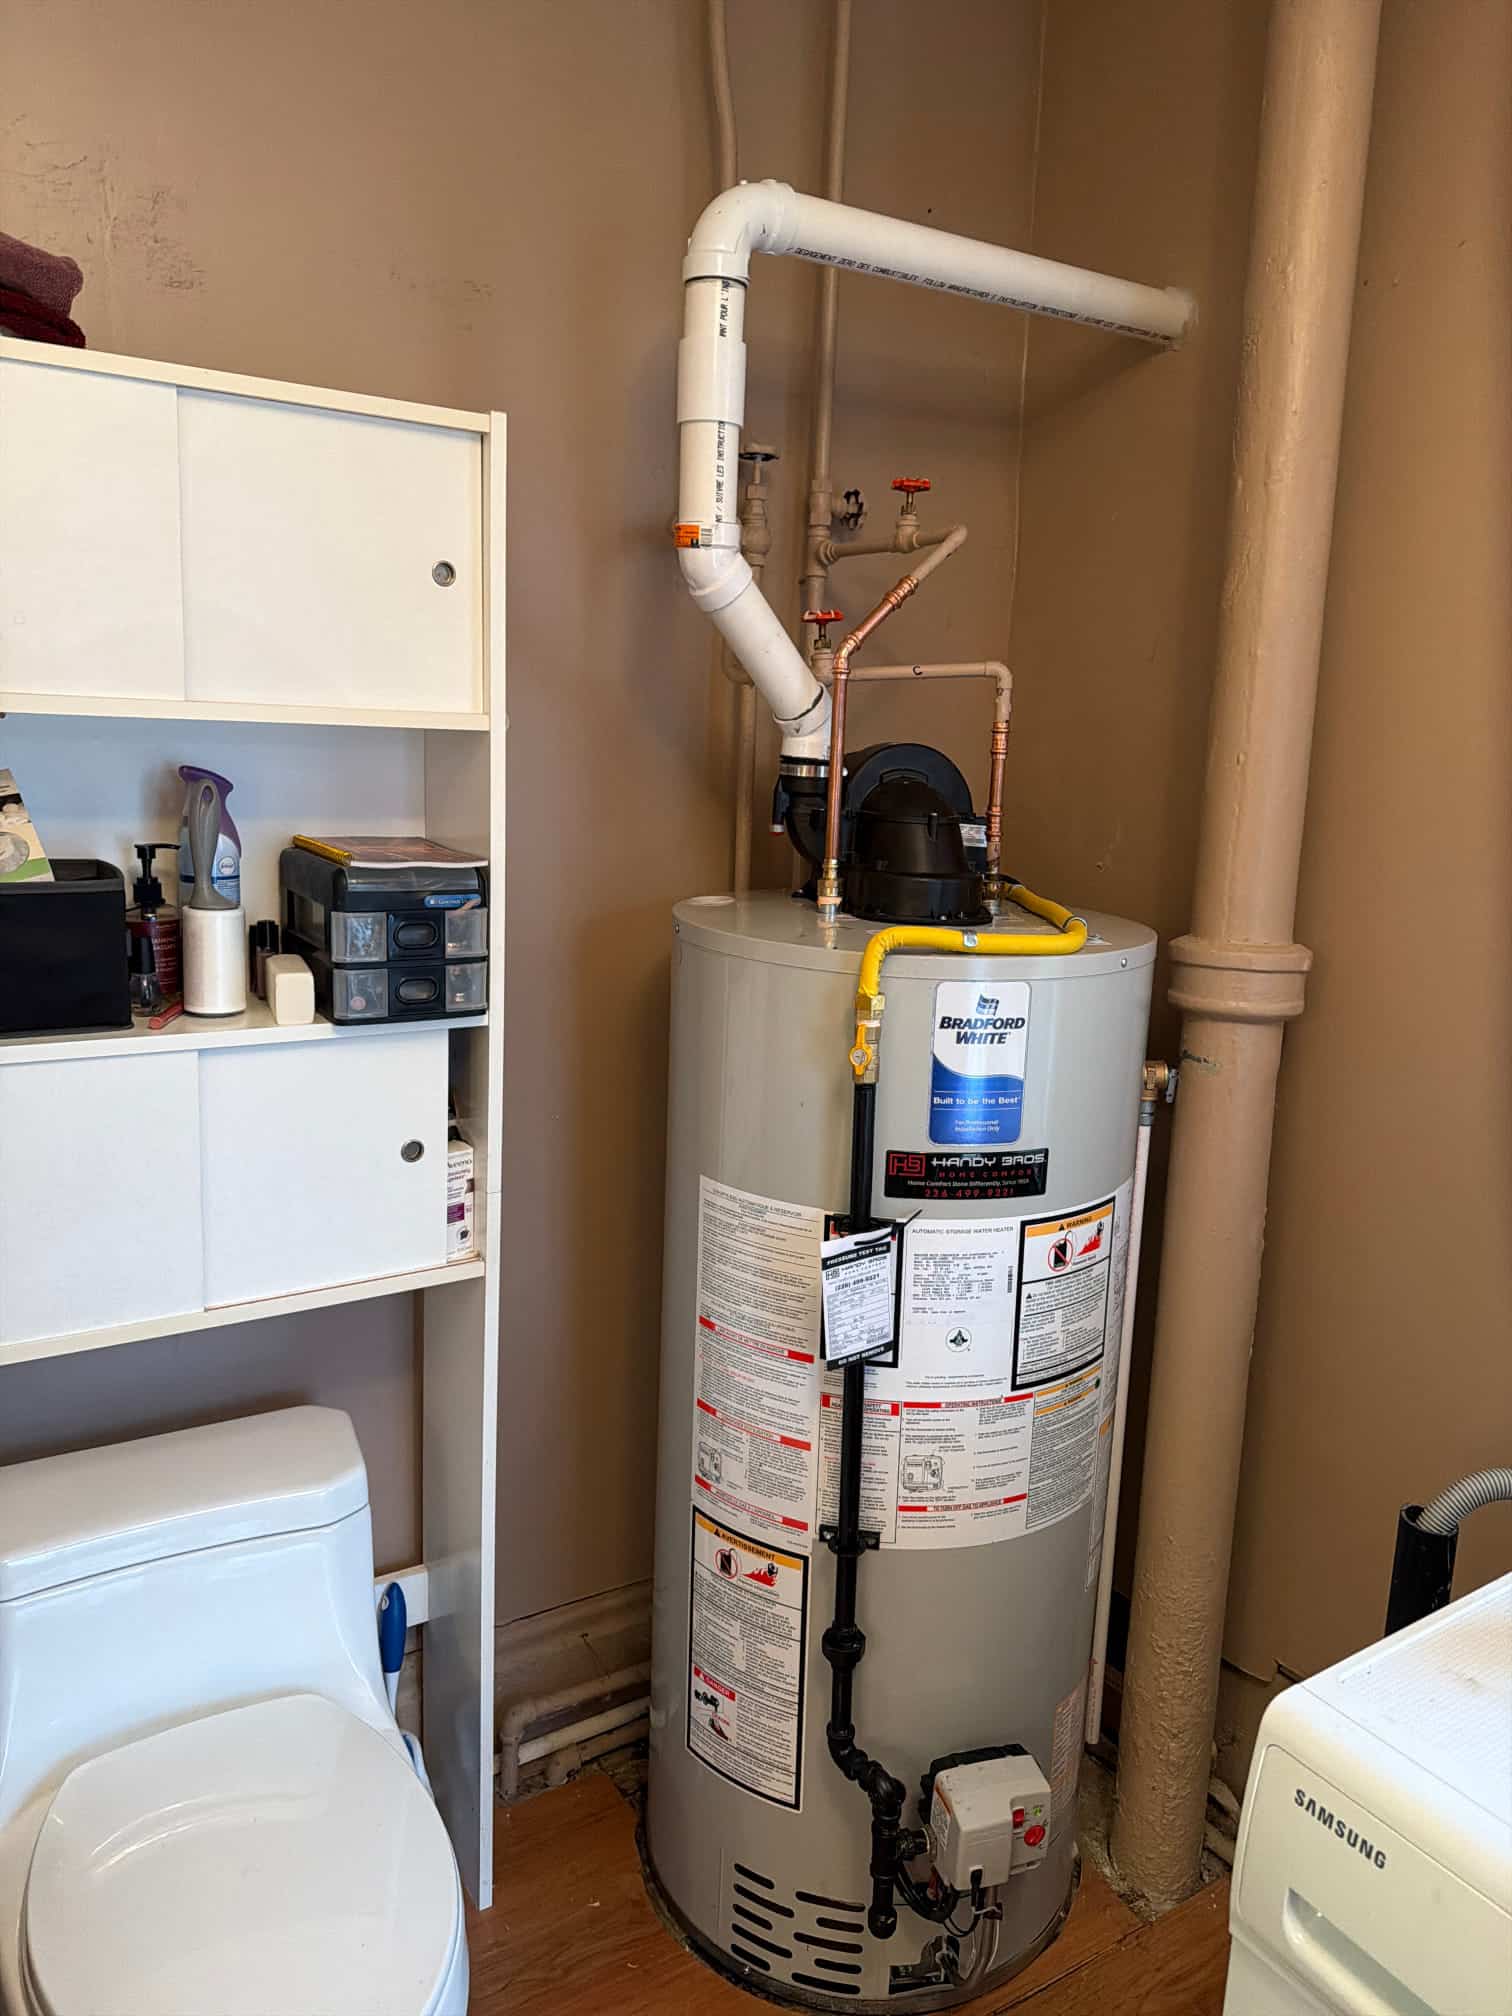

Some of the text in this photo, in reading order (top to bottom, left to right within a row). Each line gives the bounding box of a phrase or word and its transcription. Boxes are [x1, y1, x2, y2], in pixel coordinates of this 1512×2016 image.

[716, 464, 724, 478] LES
[939, 1016, 1026, 1030] BRADFORD
[955, 1031, 1008, 1045] WHITE
[933, 1096, 1019, 1105] Built to be the Best
[930, 1156, 996, 1167] HANDY
[720, 1532, 775, 1561] AVERTISSEMENT
[1294, 1788, 1387, 1870] SAMSUNG
